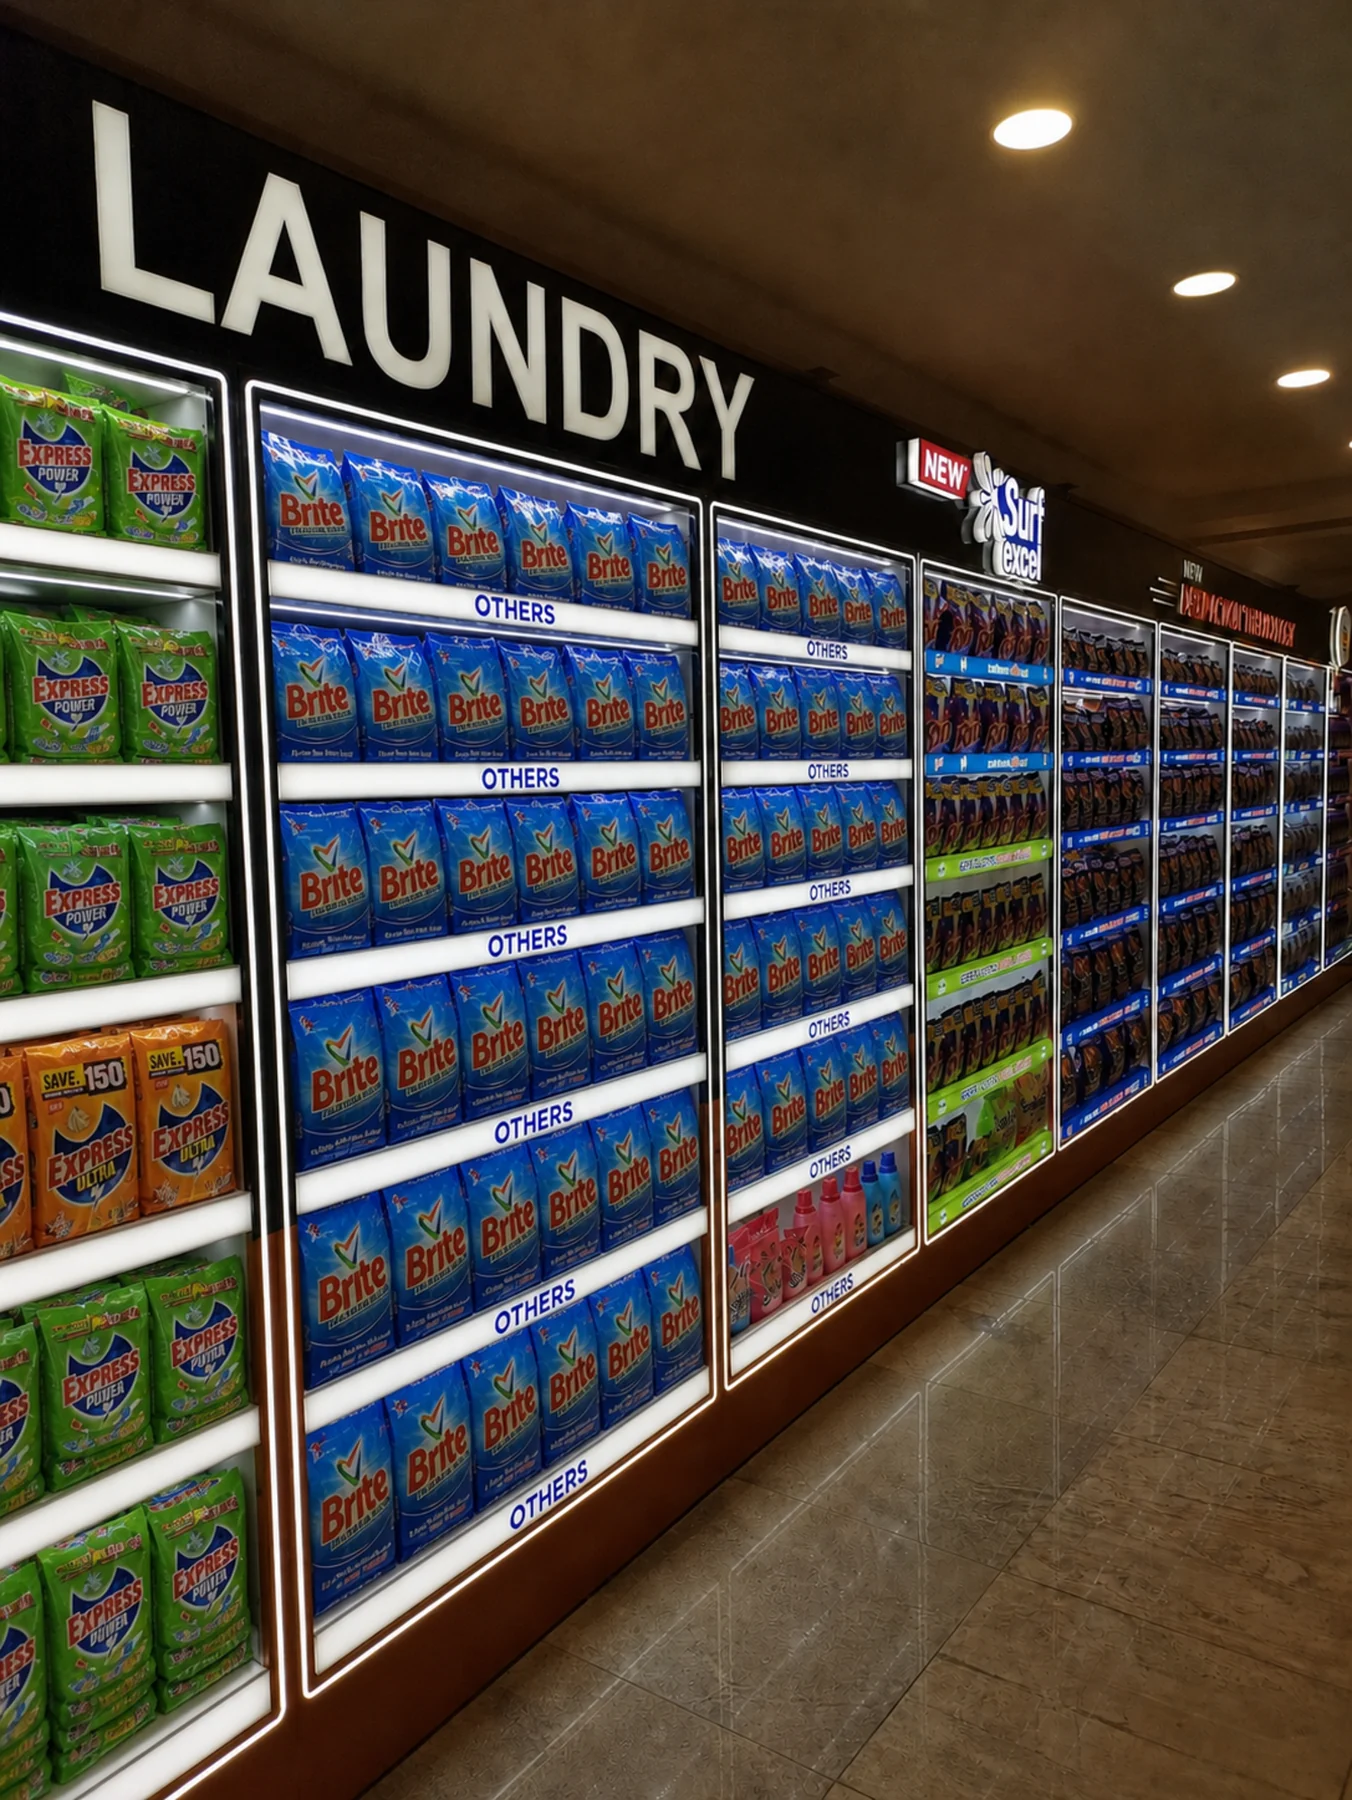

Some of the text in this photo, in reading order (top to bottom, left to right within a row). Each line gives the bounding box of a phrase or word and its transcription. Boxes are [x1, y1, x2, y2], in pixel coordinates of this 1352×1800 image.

[93, 100, 755, 480] LAUNDRY
[18, 439, 92, 468] EXPRESS
[924, 448, 965, 490] NEW
[38, 468, 78, 482] POWER
[128, 468, 196, 494] EXPRESS
[280, 492, 346, 528] Brite
[370, 510, 428, 542] Brite
[1003, 476, 1045, 544] Surf
[448, 524, 500, 558] Brite
[520, 540, 568, 570] Brite
[588, 552, 632, 580] Brite
[646, 562, 688, 590] Brite
[1003, 540, 1042, 581] excel
[722, 576, 758, 602] Brite
[766, 586, 798, 610] Brite
[808, 594, 838, 618] Brite
[474, 593, 556, 625] OTHERS
[844, 600, 872, 624] Brite
[880, 606, 906, 628] Brite
[807, 639, 847, 659] OTHERS
[33, 675, 109, 704] EXPRESS
[142, 681, 208, 708] EXPRESS
[286, 682, 350, 720] Brite
[372, 686, 432, 724] Brite
[448, 692, 502, 726] Brite
[520, 696, 568, 728] Brite
[586, 696, 630, 728] Brite
[644, 698, 686, 730] Brite
[718, 704, 756, 732] Brite
[766, 706, 798, 734] Brite
[808, 708, 838, 734] Brite
[846, 710, 874, 734] Brite
[878, 712, 906, 732] Brite
[481, 767, 561, 791] OTHERS
[807, 763, 849, 780] OTHERS
[726, 832, 762, 864] Brite
[770, 828, 804, 858] Brite
[810, 824, 842, 854] Brite
[848, 822, 876, 848] Brite
[880, 818, 906, 844] Brite
[524, 848, 574, 886] Brite
[592, 842, 636, 878] Brite
[650, 838, 690, 872] Brite
[300, 864, 364, 910] Brite
[380, 858, 440, 902] Brite
[458, 852, 512, 894] Brite
[809, 879, 852, 901] OTHERS
[44, 882, 121, 918] EXPRESS
[153, 878, 219, 911] EXPRESS
[487, 924, 568, 958] OTHERS
[846, 938, 874, 966] Brite
[878, 930, 906, 960] Brite
[768, 956, 800, 992] Brite
[808, 948, 840, 980] Brite
[652, 980, 694, 1022] Brite
[724, 971, 758, 1006] Brite
[536, 1006, 586, 1052] Brite
[598, 994, 644, 1036] Brite
[808, 1012, 850, 1038] OTHERS
[183, 1044, 221, 1070] 150
[472, 1020, 524, 1070] Brite
[84, 1061, 124, 1091] 150
[312, 1056, 380, 1112] Brite
[398, 1038, 456, 1096] Brite
[848, 1066, 878, 1100] Brite
[882, 1052, 908, 1084] Brite
[772, 1096, 806, 1134] Brite
[814, 1080, 846, 1118] Brite
[152, 1101, 229, 1160] EXPRESS
[495, 1102, 572, 1144] OTHERS
[727, 1114, 762, 1158] Brite
[48, 1124, 133, 1190] EXPRESS
[180, 1134, 215, 1163] ULTRA
[658, 1138, 698, 1182] Brite
[810, 1146, 852, 1179] OTHERS
[76, 1161, 116, 1192] ULTRA
[608, 1156, 650, 1204] Brite
[548, 1178, 598, 1230] Brite
[482, 1200, 536, 1258] Brite
[406, 1228, 468, 1288] Brite
[318, 1256, 388, 1322] Brite
[811, 1276, 853, 1314] OTHERS
[494, 1279, 576, 1334] OTHERS
[660, 1296, 700, 1346] Brite
[170, 1316, 238, 1368] EXPRESS
[608, 1324, 650, 1380] Brite
[62, 1349, 140, 1408] EXPRESS
[550, 1354, 596, 1410] Brite
[484, 1386, 536, 1450] Brite
[408, 1424, 468, 1494] Brite
[320, 1468, 390, 1544] Brite
[510, 1460, 588, 1530] OTHERS
[173, 1536, 238, 1602] EXPRESS
[67, 1578, 142, 1649] EXPRESS
